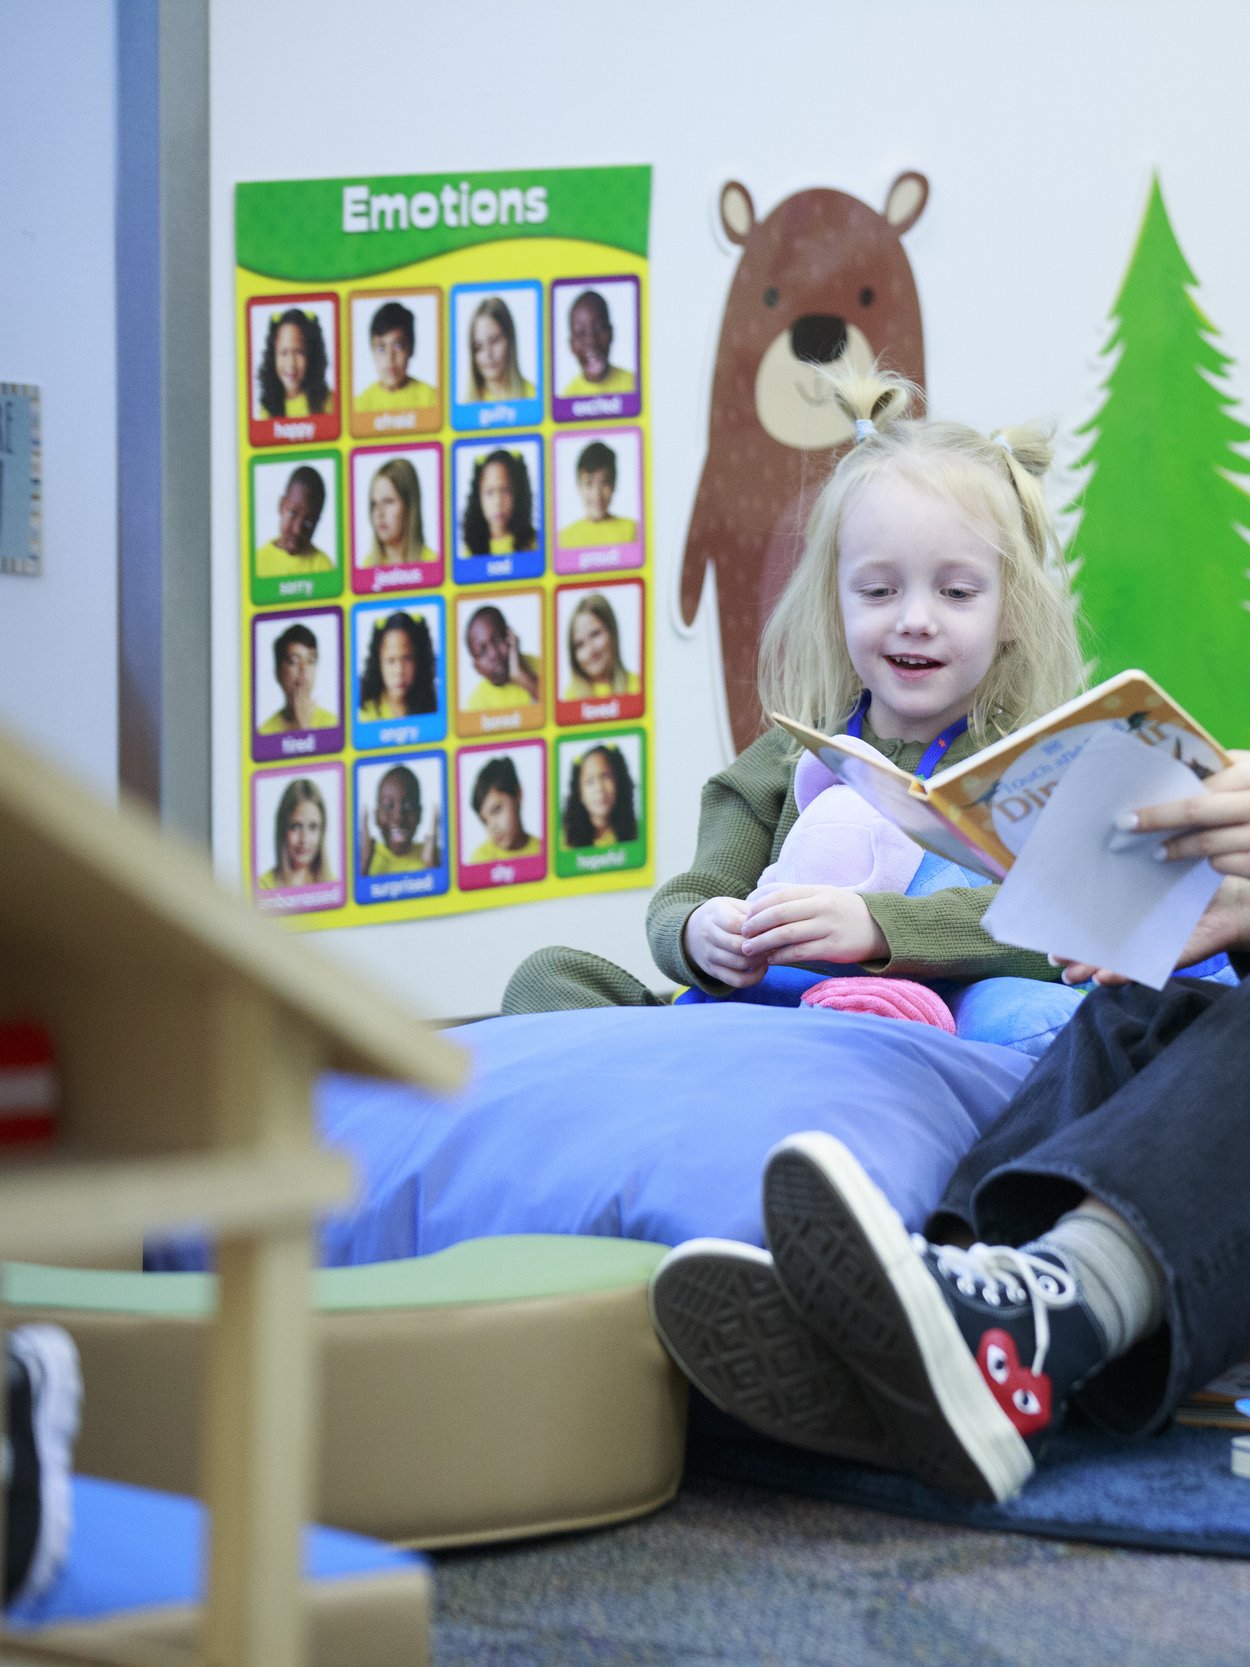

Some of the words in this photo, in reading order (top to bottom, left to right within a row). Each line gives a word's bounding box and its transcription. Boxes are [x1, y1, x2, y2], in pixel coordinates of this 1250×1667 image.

[342, 182, 548, 233] Emotions
[573, 396, 622, 416] excited
[274, 421, 315, 441] happy
[374, 411, 417, 431] afraid
[487, 558, 512, 577] sad
[579, 548, 619, 568] proud
[280, 579, 313, 596] sorry
[372, 568, 422, 591] jealous
[582, 699, 621, 720] loved
[282, 731, 316, 753] tired
[380, 726, 419, 746] angry
[577, 849, 625, 871] hopeful
[490, 864, 516, 883] shy
[371, 874, 433, 898] surprised
